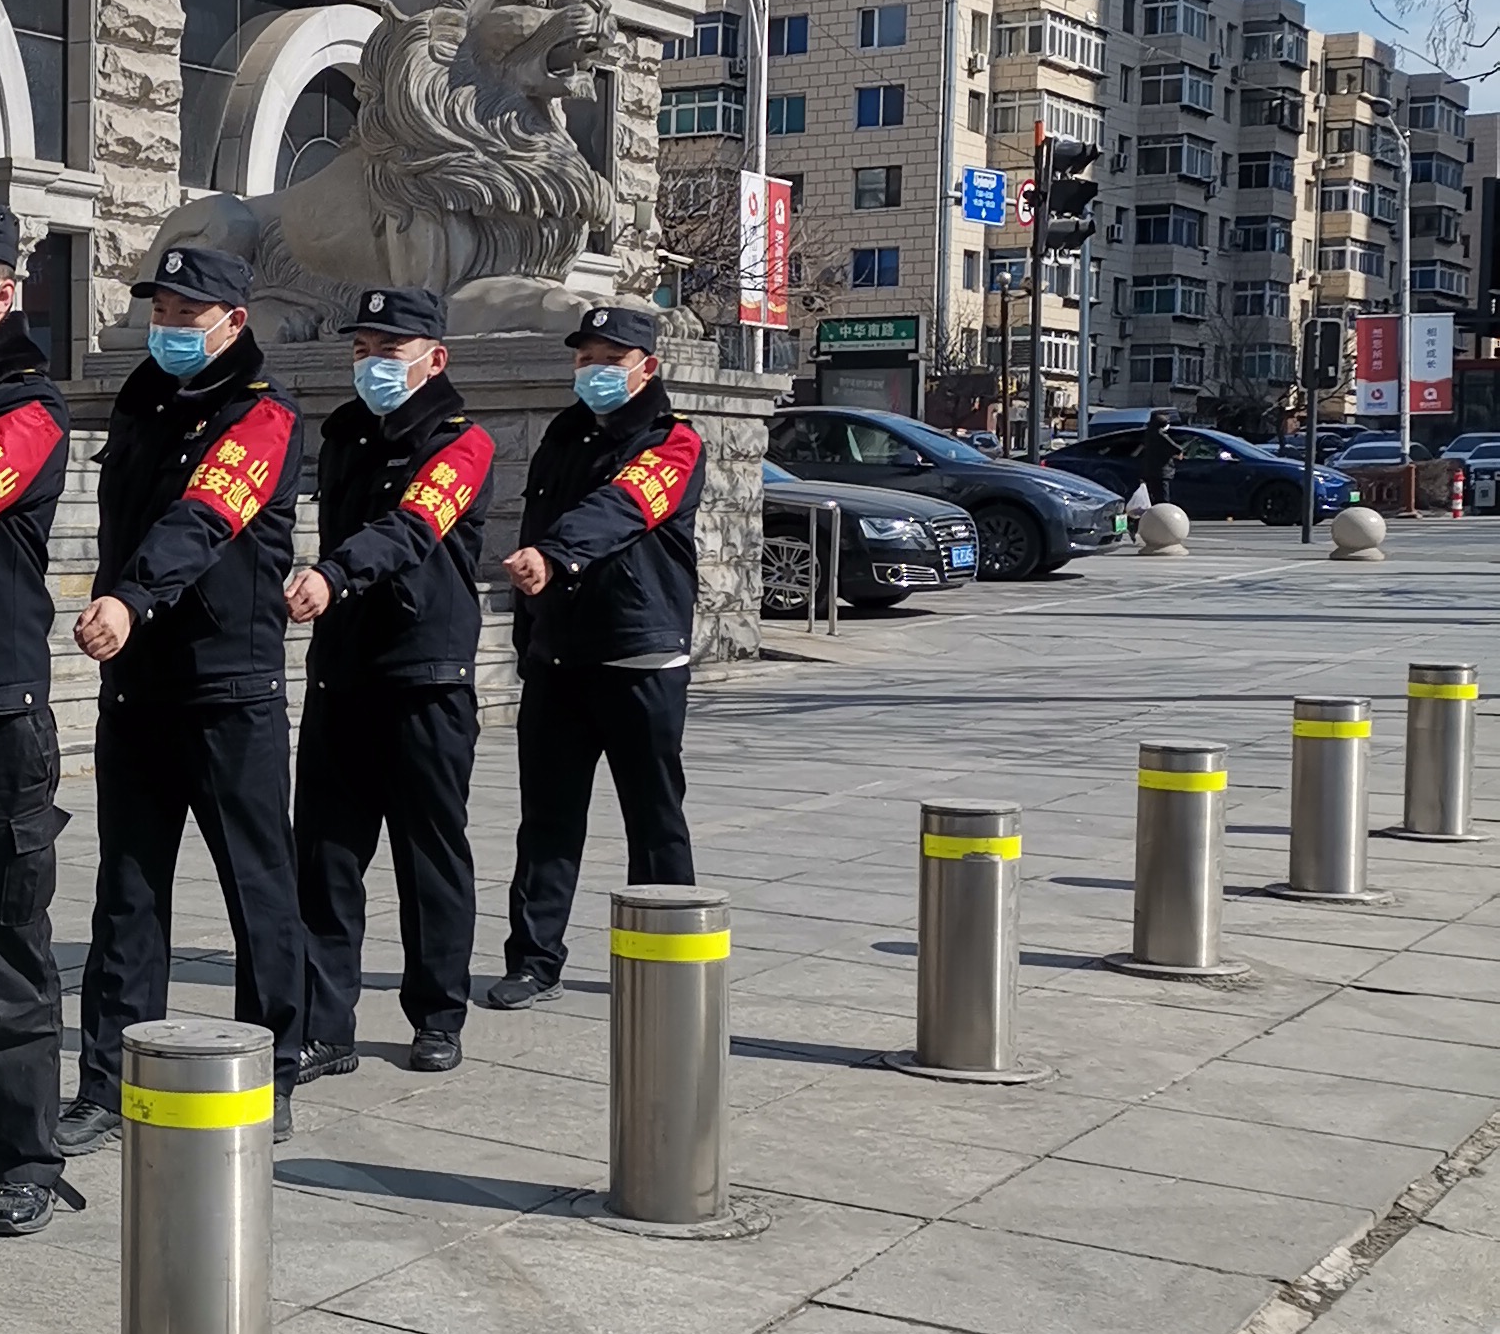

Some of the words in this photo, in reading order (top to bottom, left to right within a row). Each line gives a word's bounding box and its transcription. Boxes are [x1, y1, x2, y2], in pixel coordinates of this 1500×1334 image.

[839, 322, 895, 339] 中华南路
[216, 439, 269, 488] 鞍山
[430, 461, 473, 510] 鞍山
[403, 482, 457, 536] 保安巡
[613, 466, 670, 519] 安巡防
